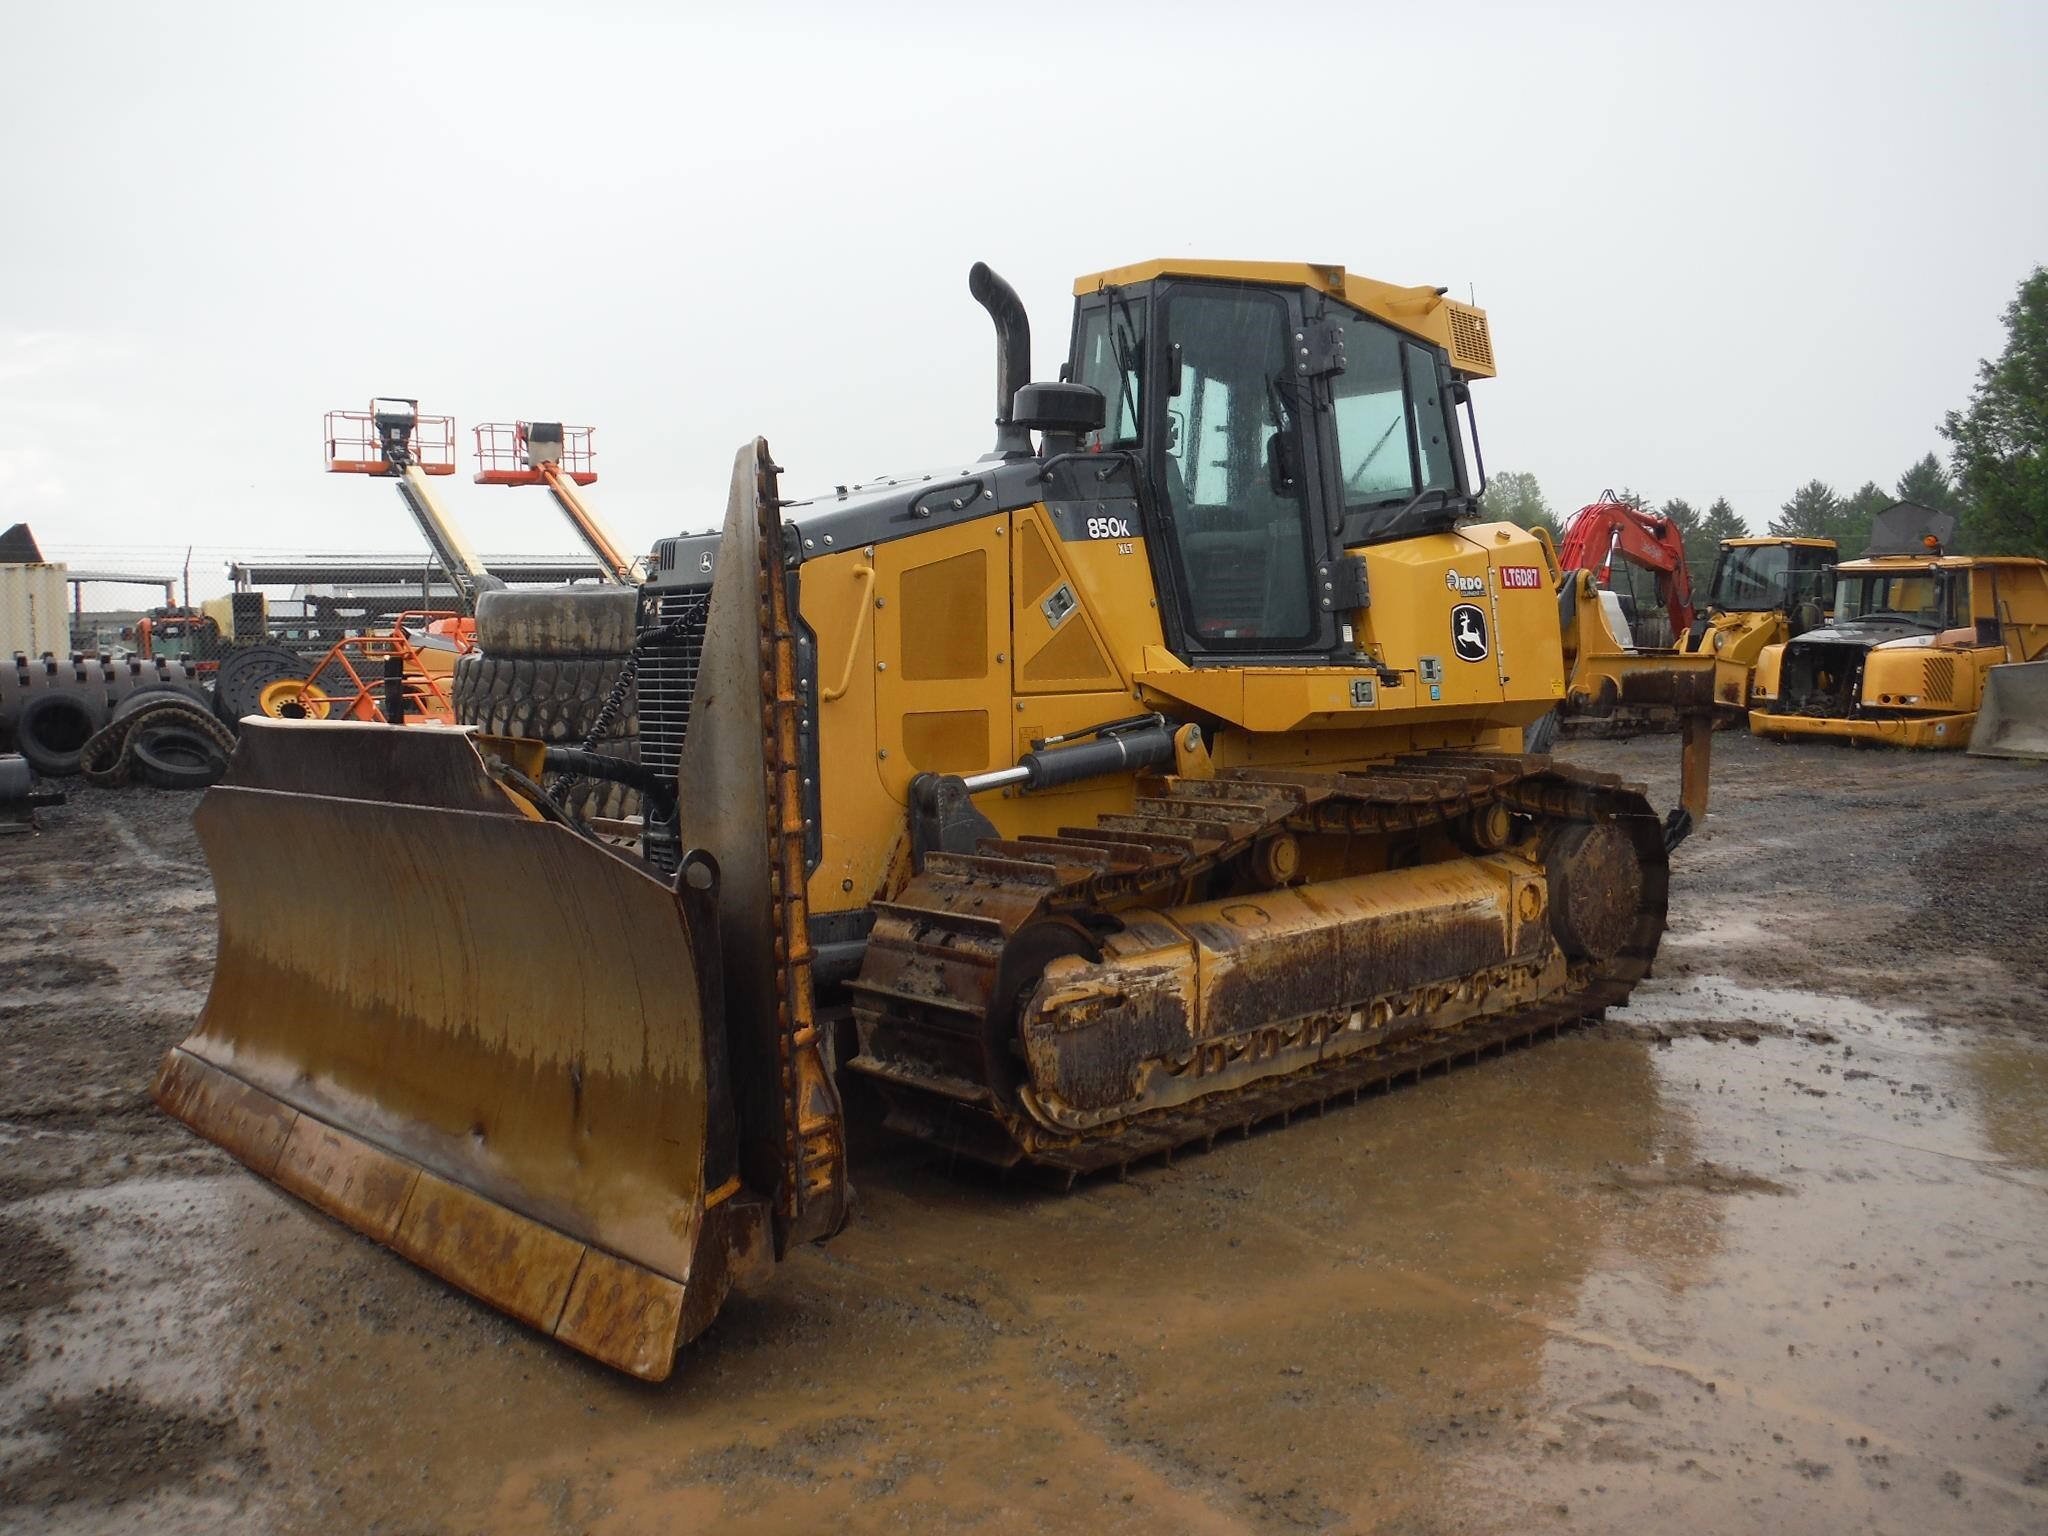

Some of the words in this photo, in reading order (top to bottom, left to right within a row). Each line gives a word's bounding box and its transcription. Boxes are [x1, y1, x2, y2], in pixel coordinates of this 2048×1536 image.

[1087, 517, 1131, 539] 850K
[1118, 543, 1134, 554] XLT
[1502, 568, 1538, 587] LT6D87
